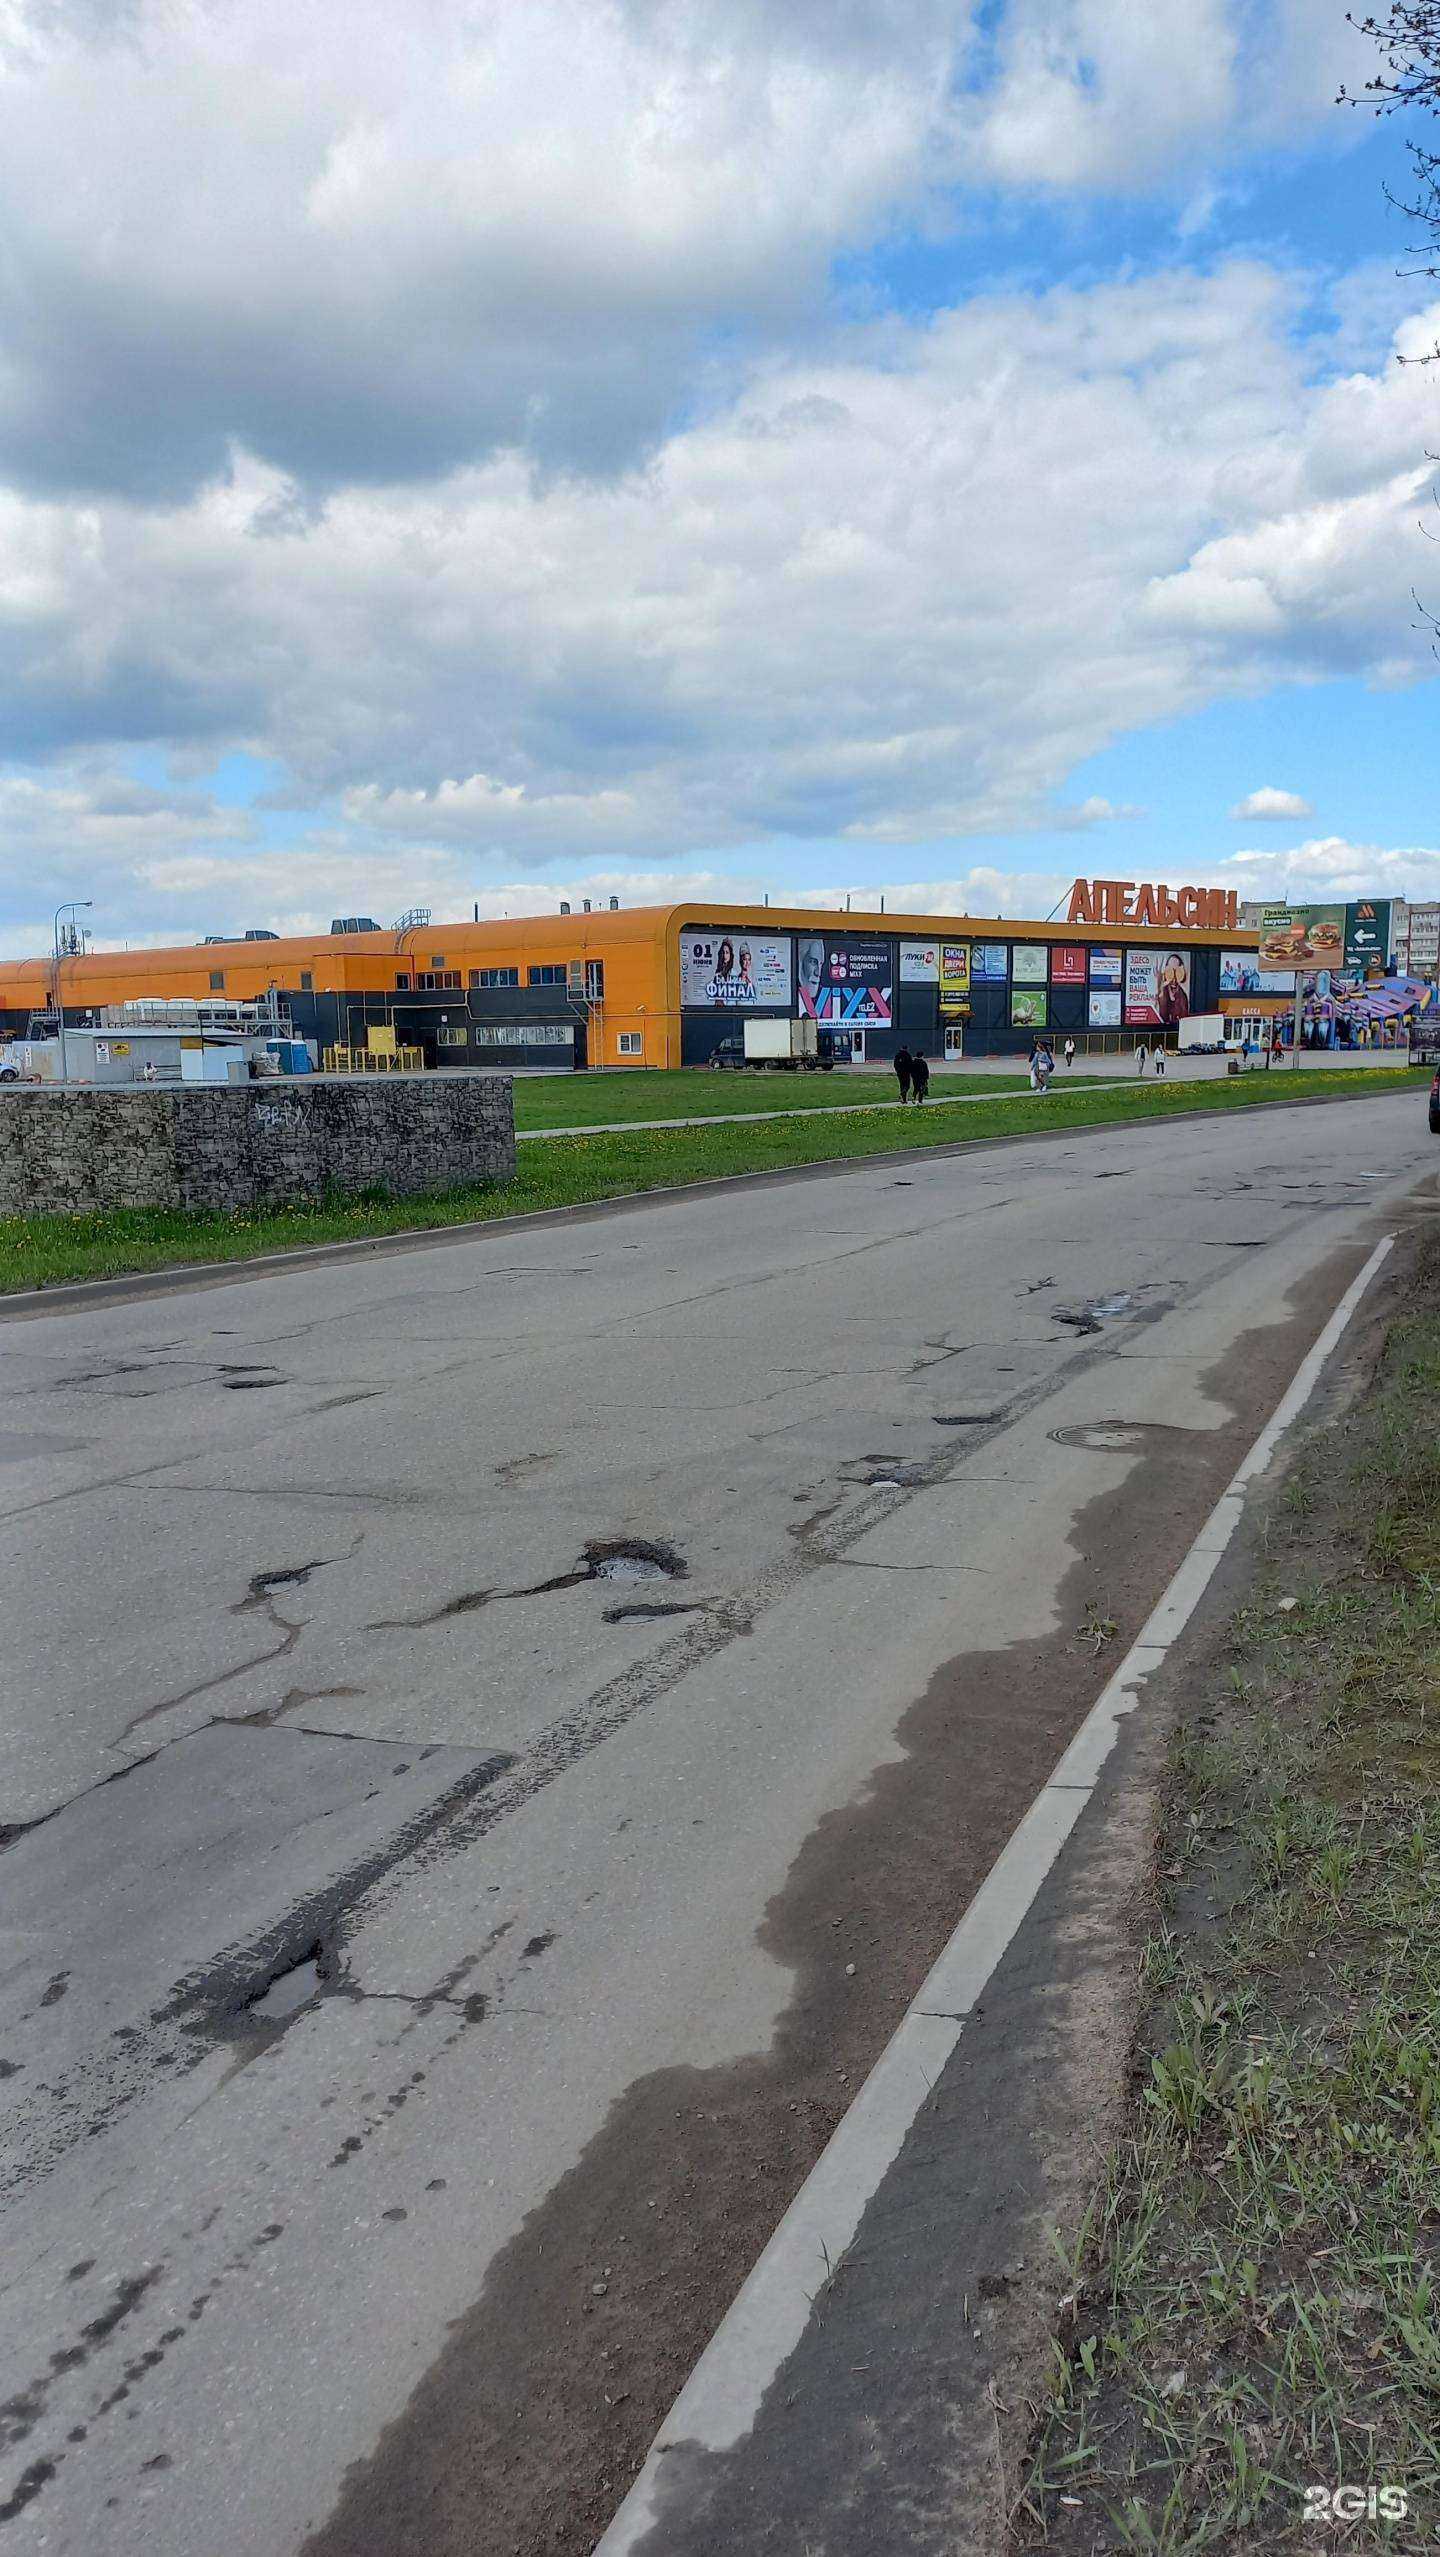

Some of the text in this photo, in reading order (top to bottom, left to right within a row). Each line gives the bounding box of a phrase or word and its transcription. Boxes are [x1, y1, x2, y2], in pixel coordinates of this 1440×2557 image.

[1068, 879, 1238, 930] АПЕЛЬСИН
[693, 944, 712, 958] 01
[944, 948, 965, 959] ОКНА
[1130, 967, 1152, 975] МОЖЕТ
[1130, 976, 1147, 984] БЫТЬ
[706, 980, 756, 997] ФИНАЛ
[858, 1002, 875, 1012] TELE2
